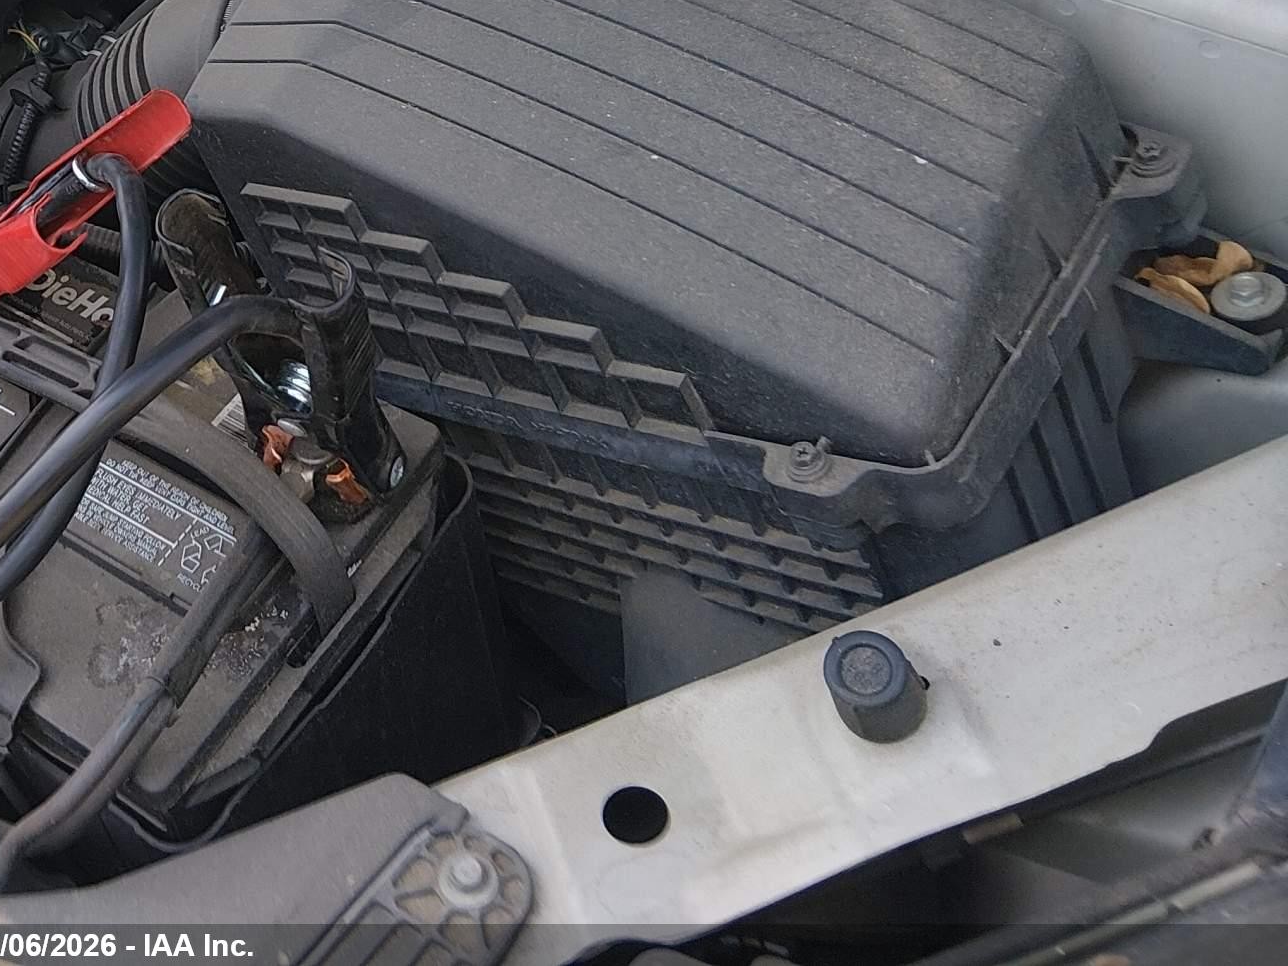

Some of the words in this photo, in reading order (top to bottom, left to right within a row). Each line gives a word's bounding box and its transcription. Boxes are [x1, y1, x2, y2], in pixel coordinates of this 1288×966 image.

[85, 483, 113, 503] EDICAL
[110, 497, 133, 515] HELP
[129, 508, 150, 525] FAST
[94, 467, 119, 486] FLUSH
[115, 479, 137, 496] EYES
[134, 489, 182, 521] IMMEDIATELY
[175, 571, 205, 593] RECYCL
